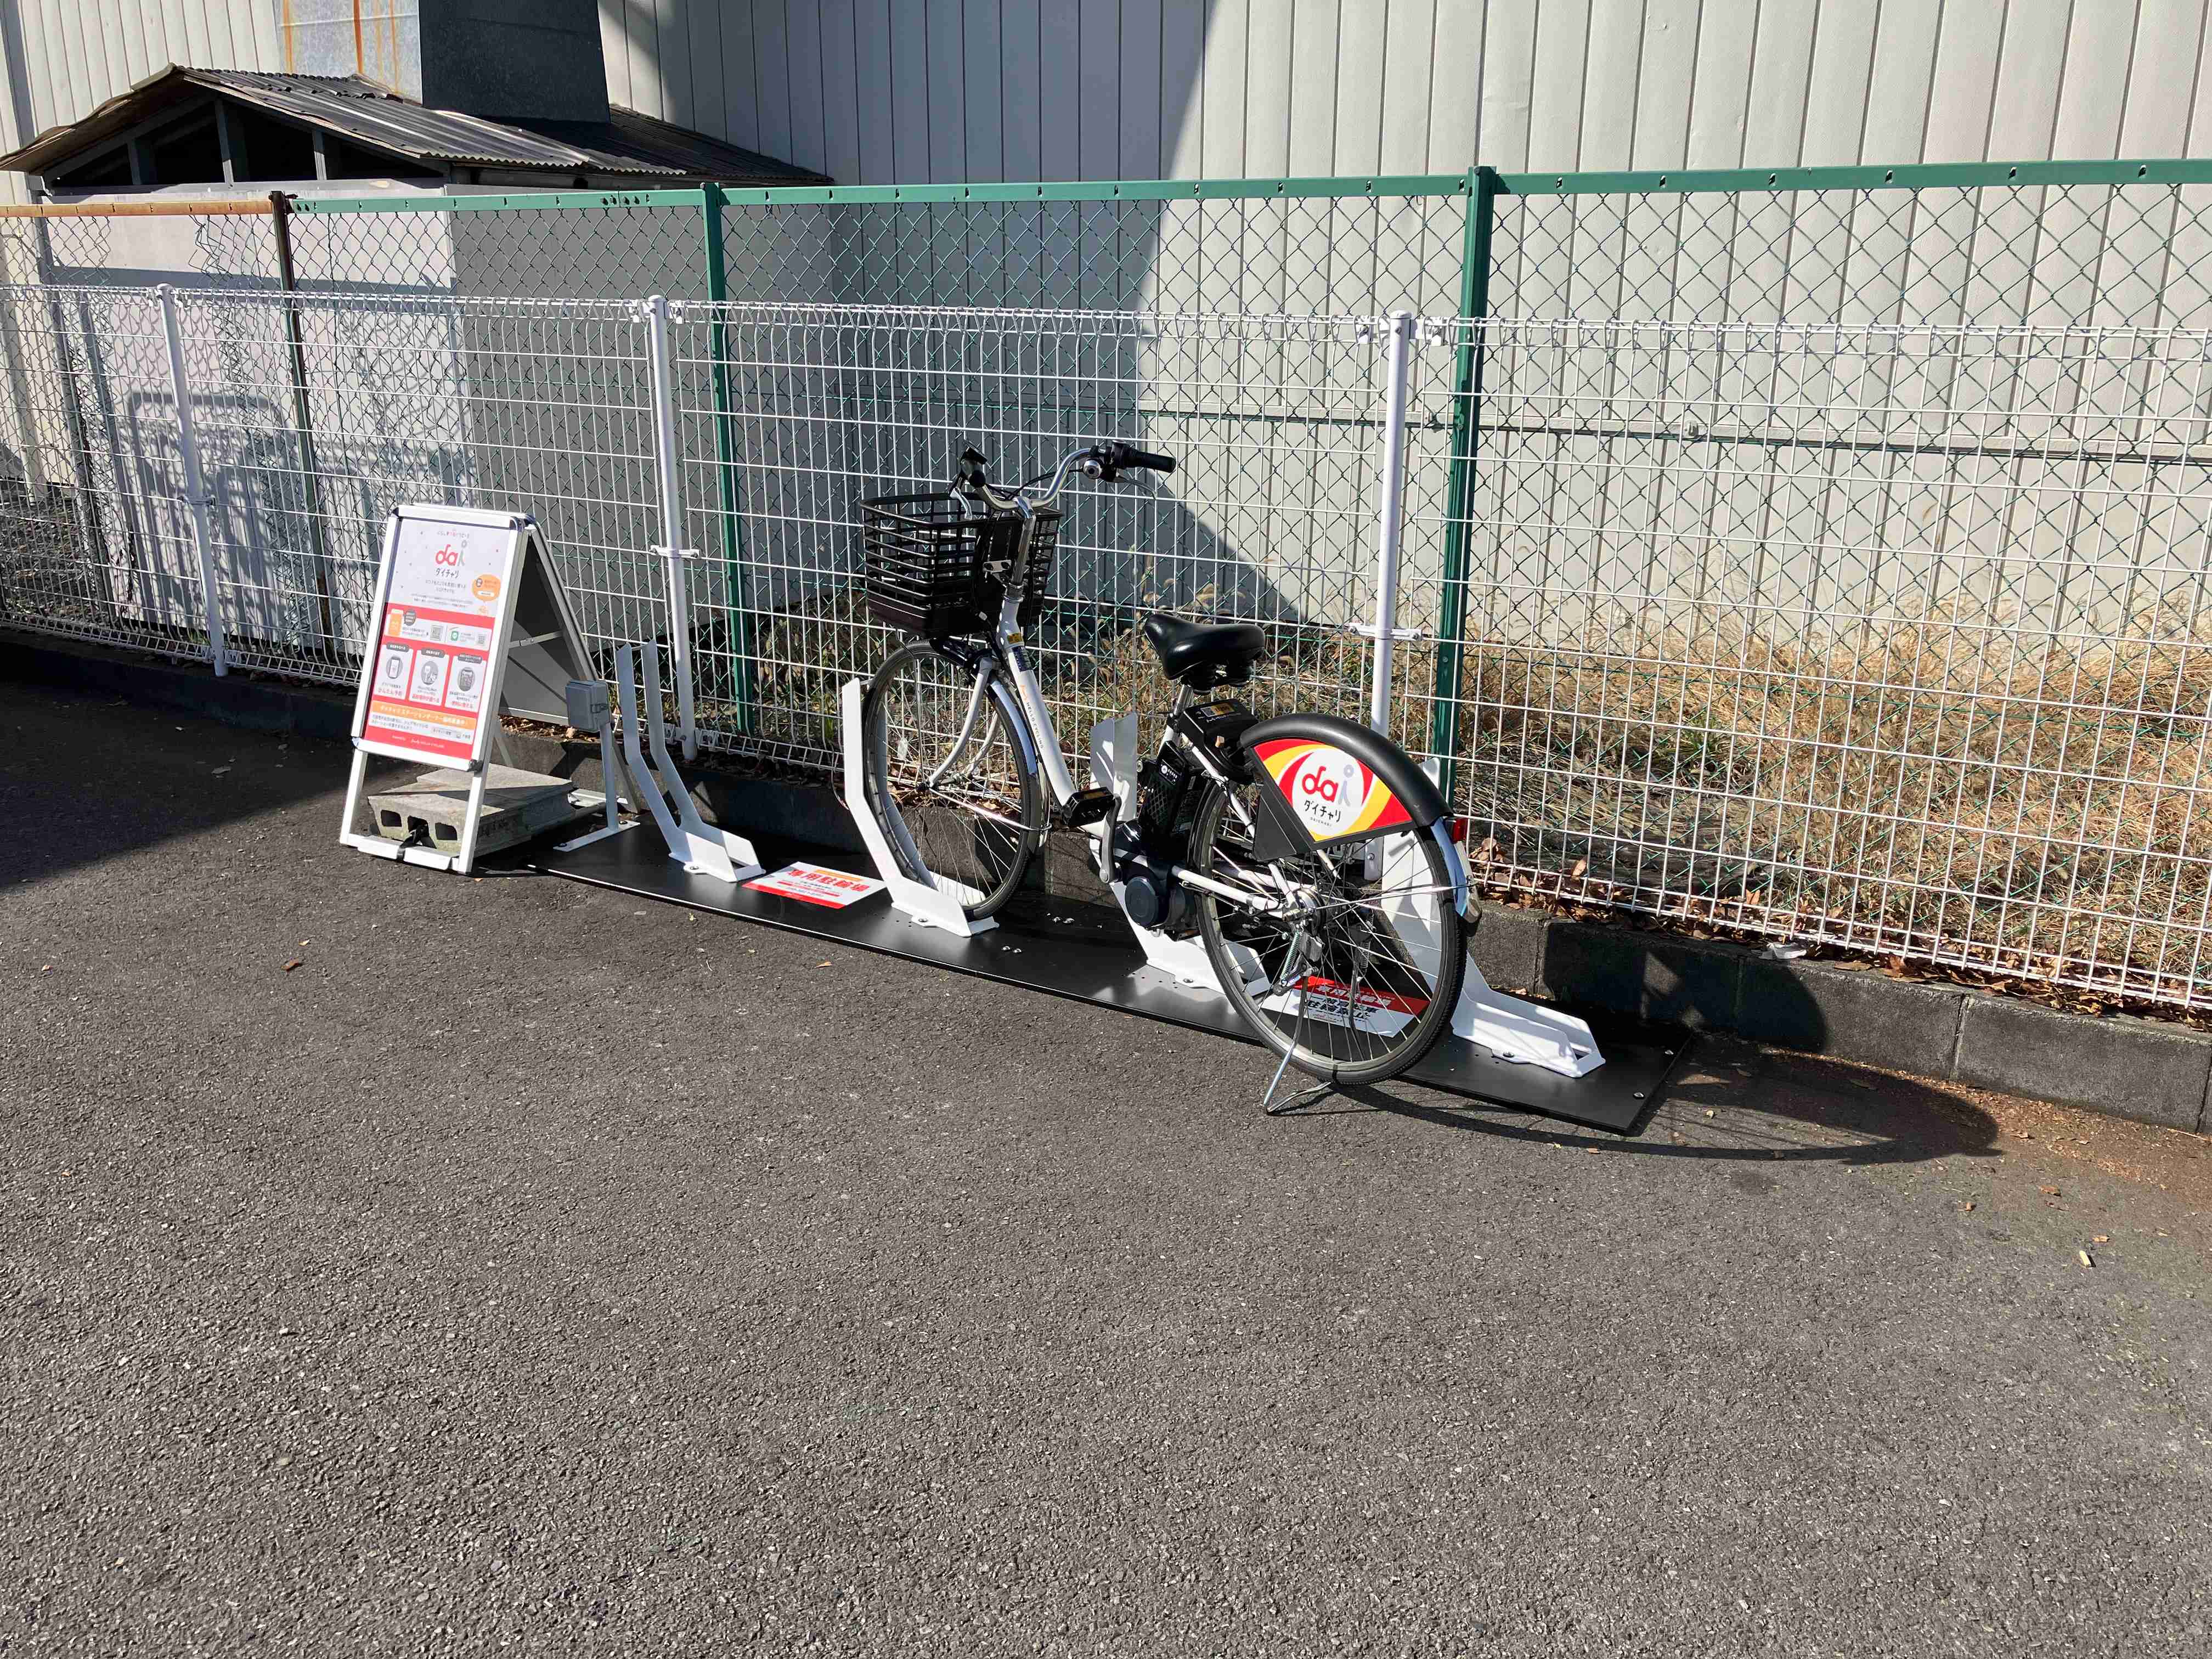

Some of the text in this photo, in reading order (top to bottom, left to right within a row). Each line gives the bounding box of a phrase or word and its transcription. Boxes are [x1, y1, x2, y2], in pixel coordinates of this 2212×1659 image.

[435, 567, 460, 579] ダイチャリ
[1304, 799, 1341, 822] ダイチャリ
